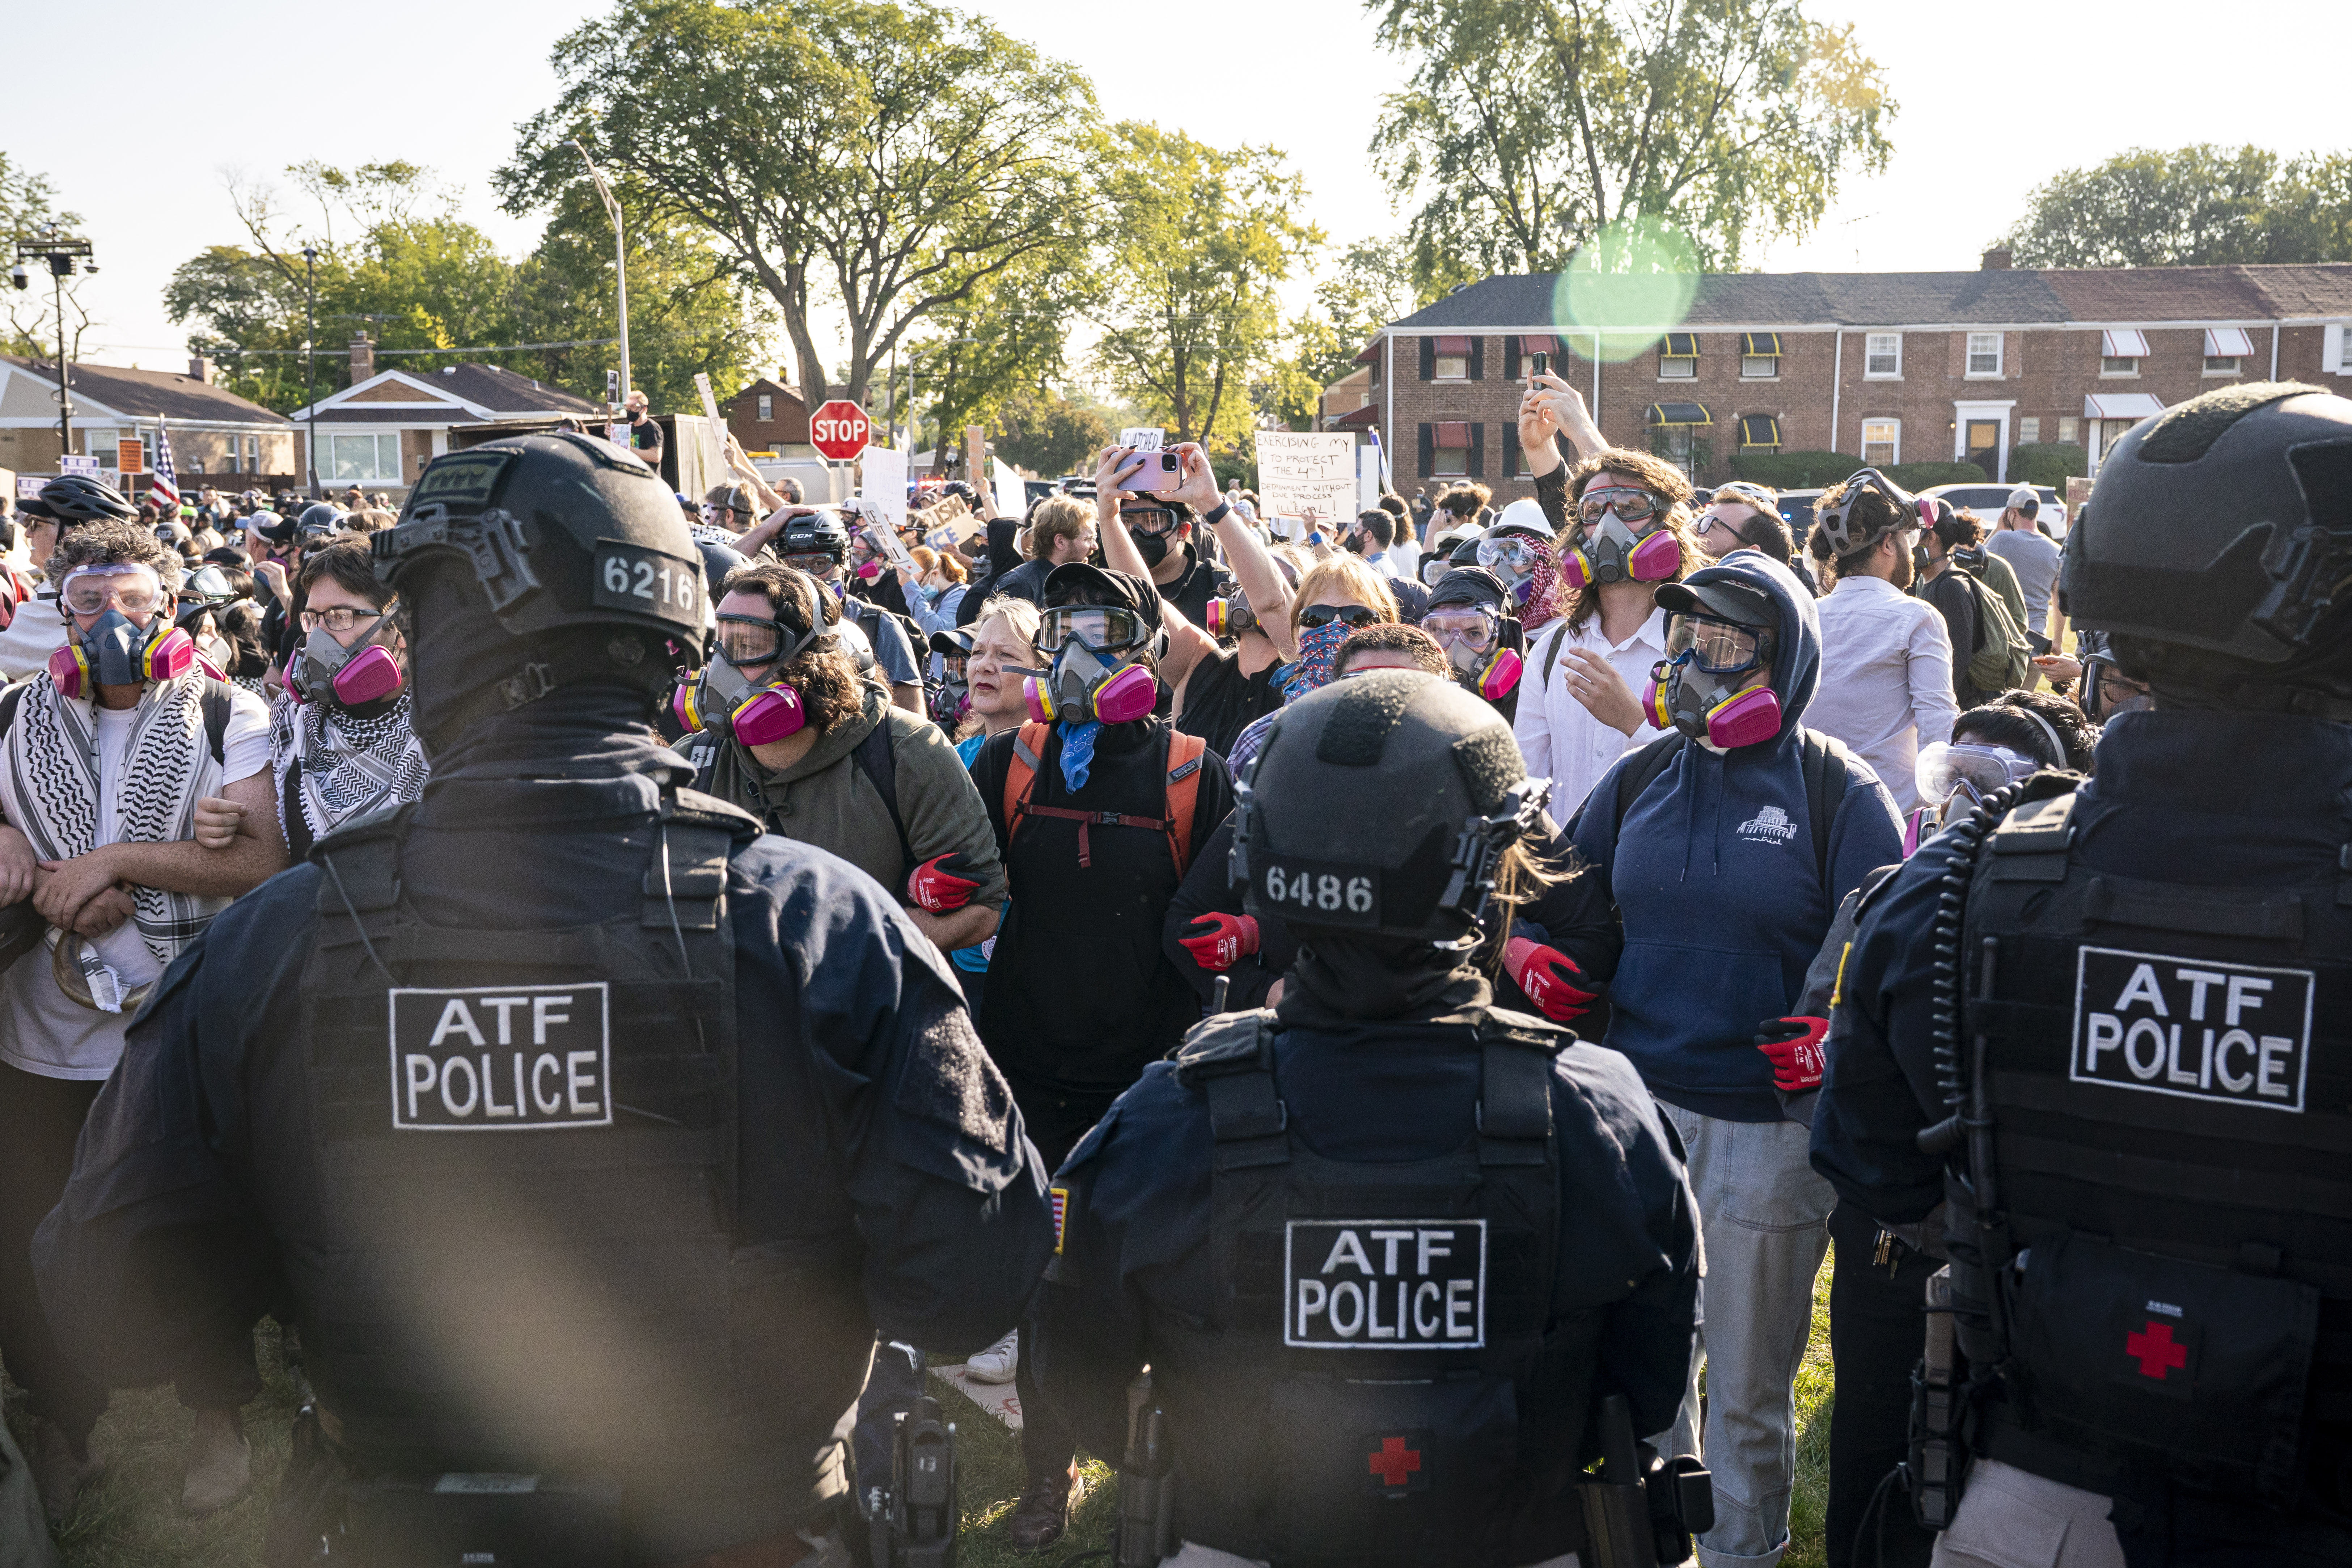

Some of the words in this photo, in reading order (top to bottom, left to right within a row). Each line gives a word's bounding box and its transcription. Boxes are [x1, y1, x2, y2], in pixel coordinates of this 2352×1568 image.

[815, 420, 866, 442] STOP
[1257, 434, 1319, 448] EXERCISING
[1329, 438, 1349, 452] MY
[1270, 454, 1282, 463] TO
[1286, 455, 1339, 465] PROTECT
[1273, 466, 1293, 475] THE
[1261, 482, 1308, 492] DETAINMENT
[1313, 483, 1351, 493] WITHOUT
[1277, 504, 1327, 514] ILLEGAL
[925, 527, 959, 551] ICE
[604, 557, 693, 611] 6216
[1175, 765, 1196, 778] patagonia
[1742, 836, 1783, 845] montréal
[1266, 866, 1373, 912] 6486
[2114, 963, 2273, 1026] ATF
[429, 996, 573, 1047] ATF
[2085, 1012, 2293, 1097] POLICE
[406, 1050, 600, 1118] POLICE
[1321, 1229, 1455, 1276] ATF
[1297, 1278, 1474, 1339] POLICE
